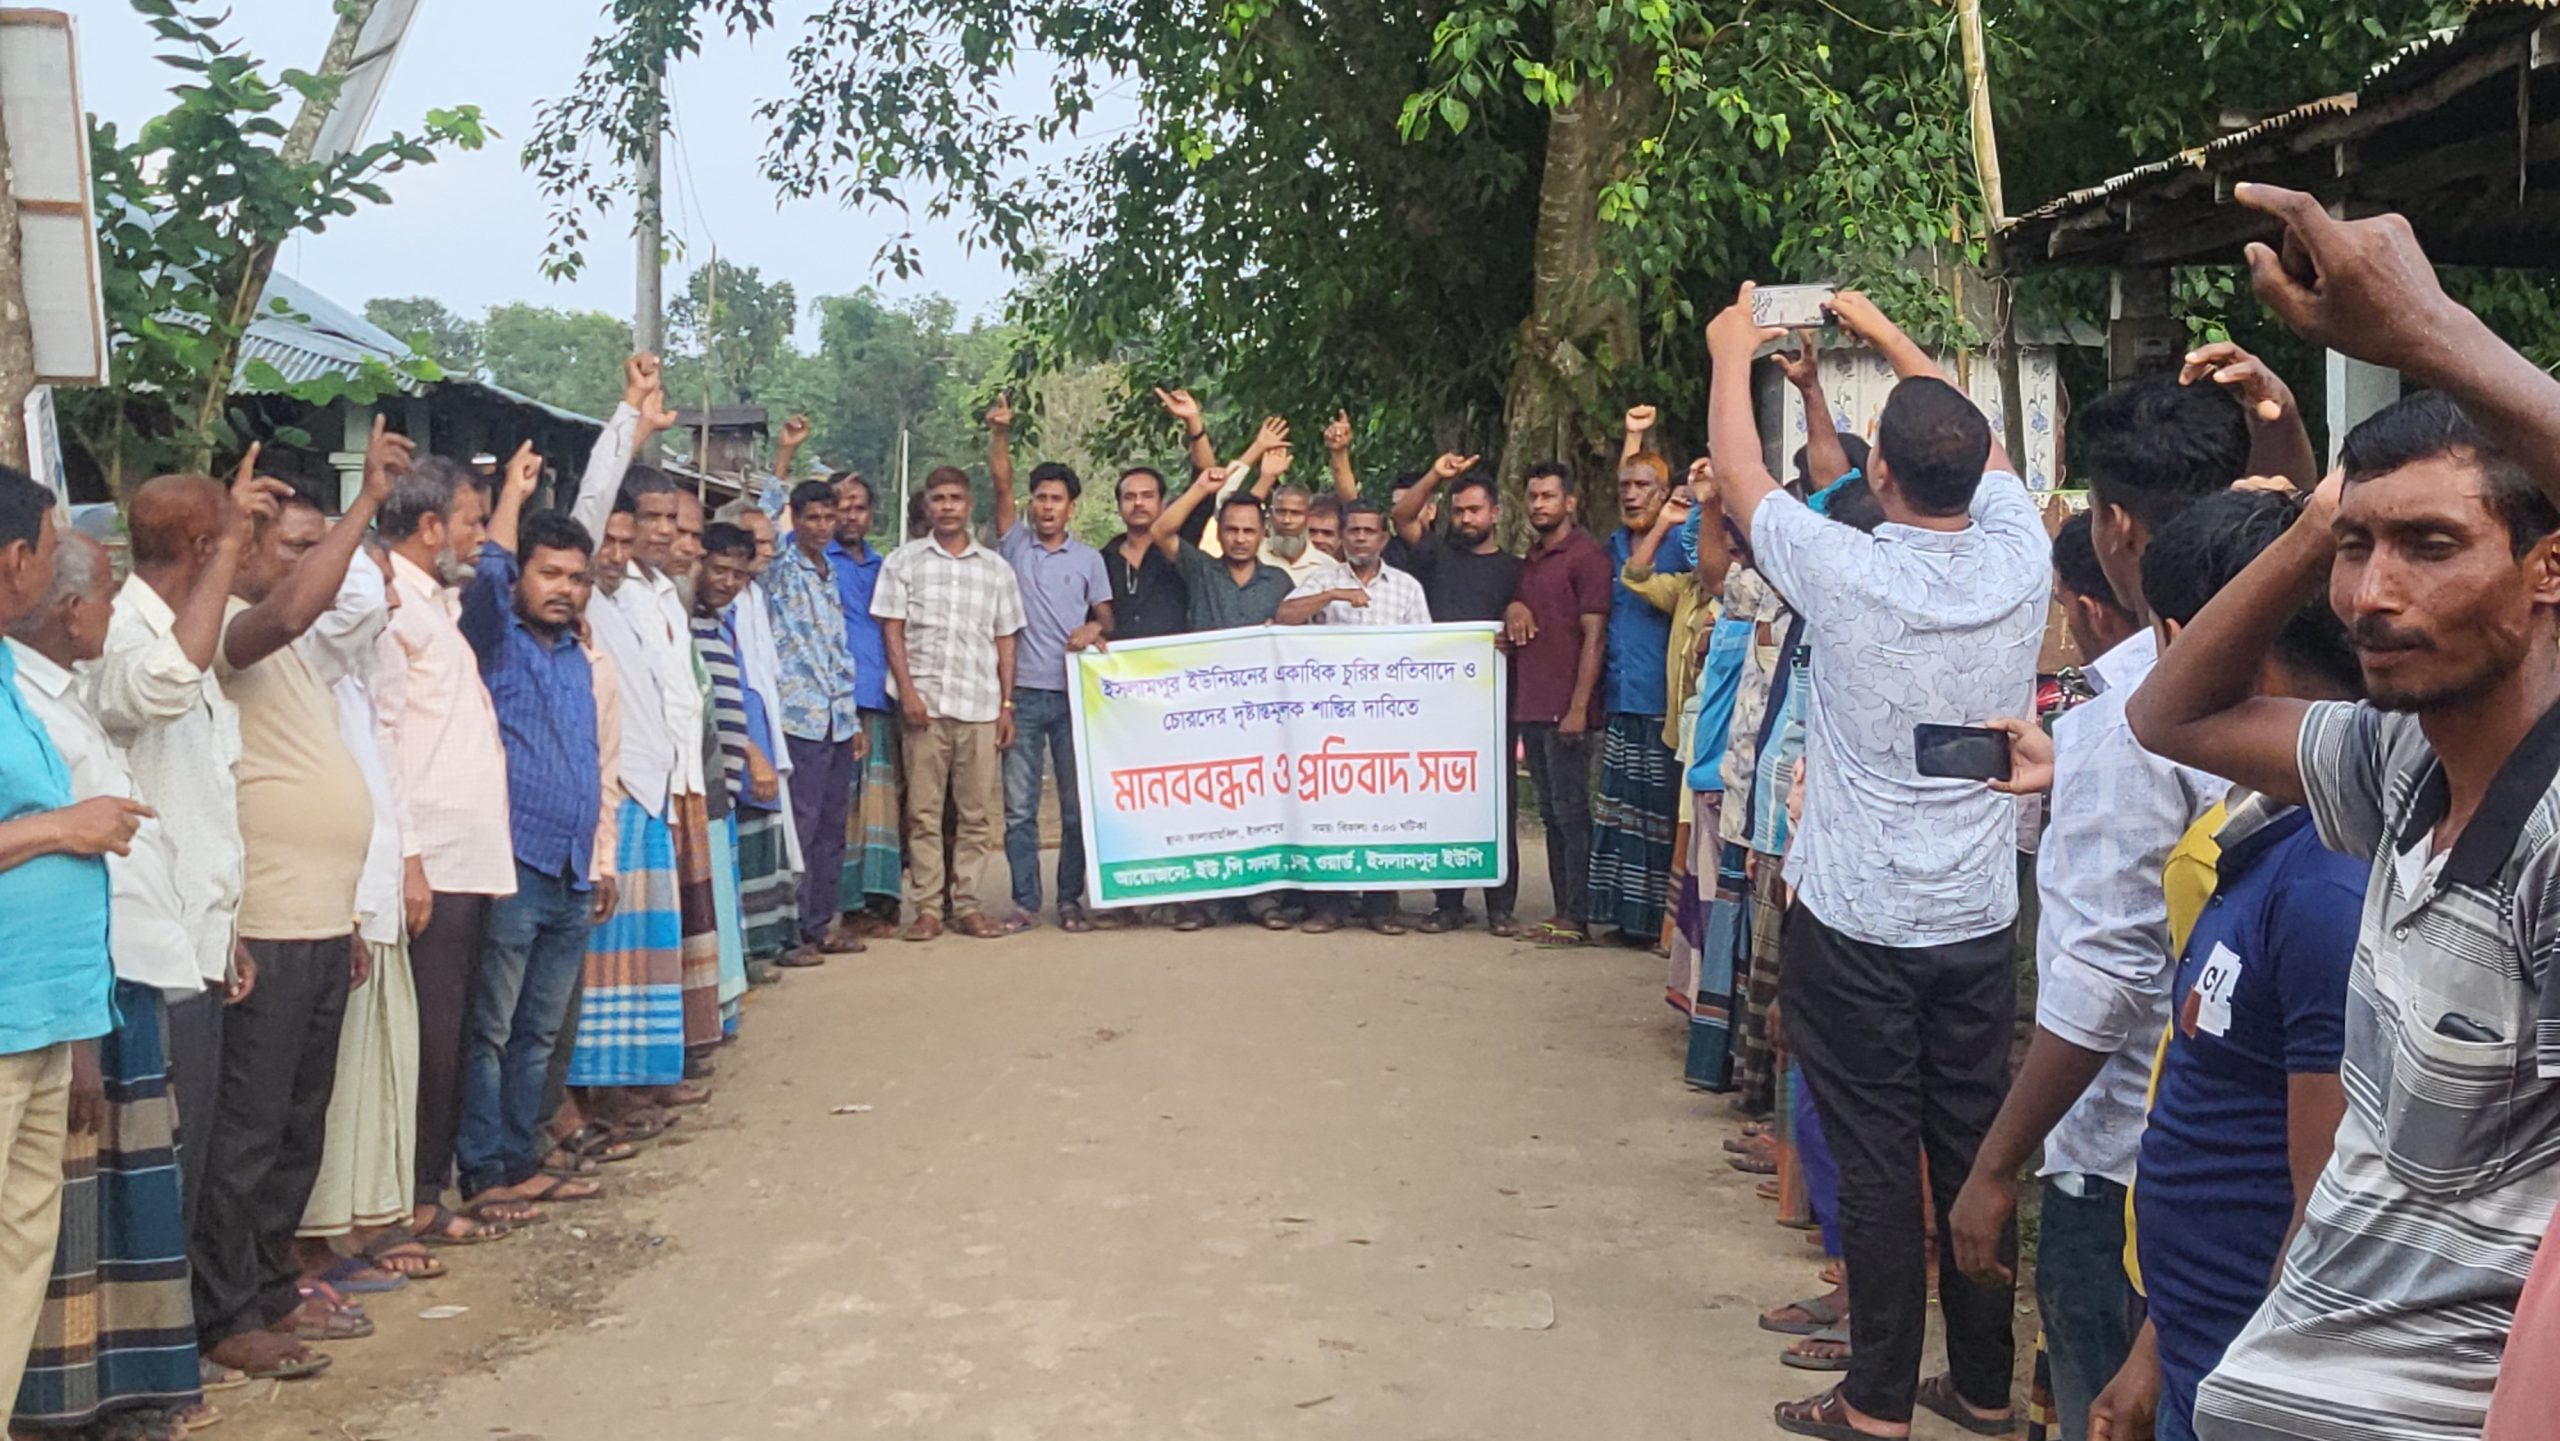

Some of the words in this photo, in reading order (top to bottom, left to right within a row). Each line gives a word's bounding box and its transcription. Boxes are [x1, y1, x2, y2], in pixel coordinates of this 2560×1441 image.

[1101, 676, 1180, 699] ইসলামপুর
[1185, 665, 1268, 691] ইউনিয়নের
[1274, 658, 1337, 684] একাধিক
[1342, 657, 1380, 688] চুরির
[1385, 656, 1457, 683] প্রতিবাদে
[1462, 662, 1477, 679] ও
[1163, 707, 1227, 731] চোরদের
[1311, 694, 1357, 719] শাস্তির
[1362, 693, 1420, 719] দাবিতে
[1111, 755, 1264, 811] মানববন্ধন
[1273, 753, 1291, 794] ও
[1298, 735, 1410, 802] প্রতিবাদ
[1417, 750, 1478, 793] সভা
[1365, 849, 1438, 873] ইসলামপুর
[1441, 846, 1484, 869] ইউপি
